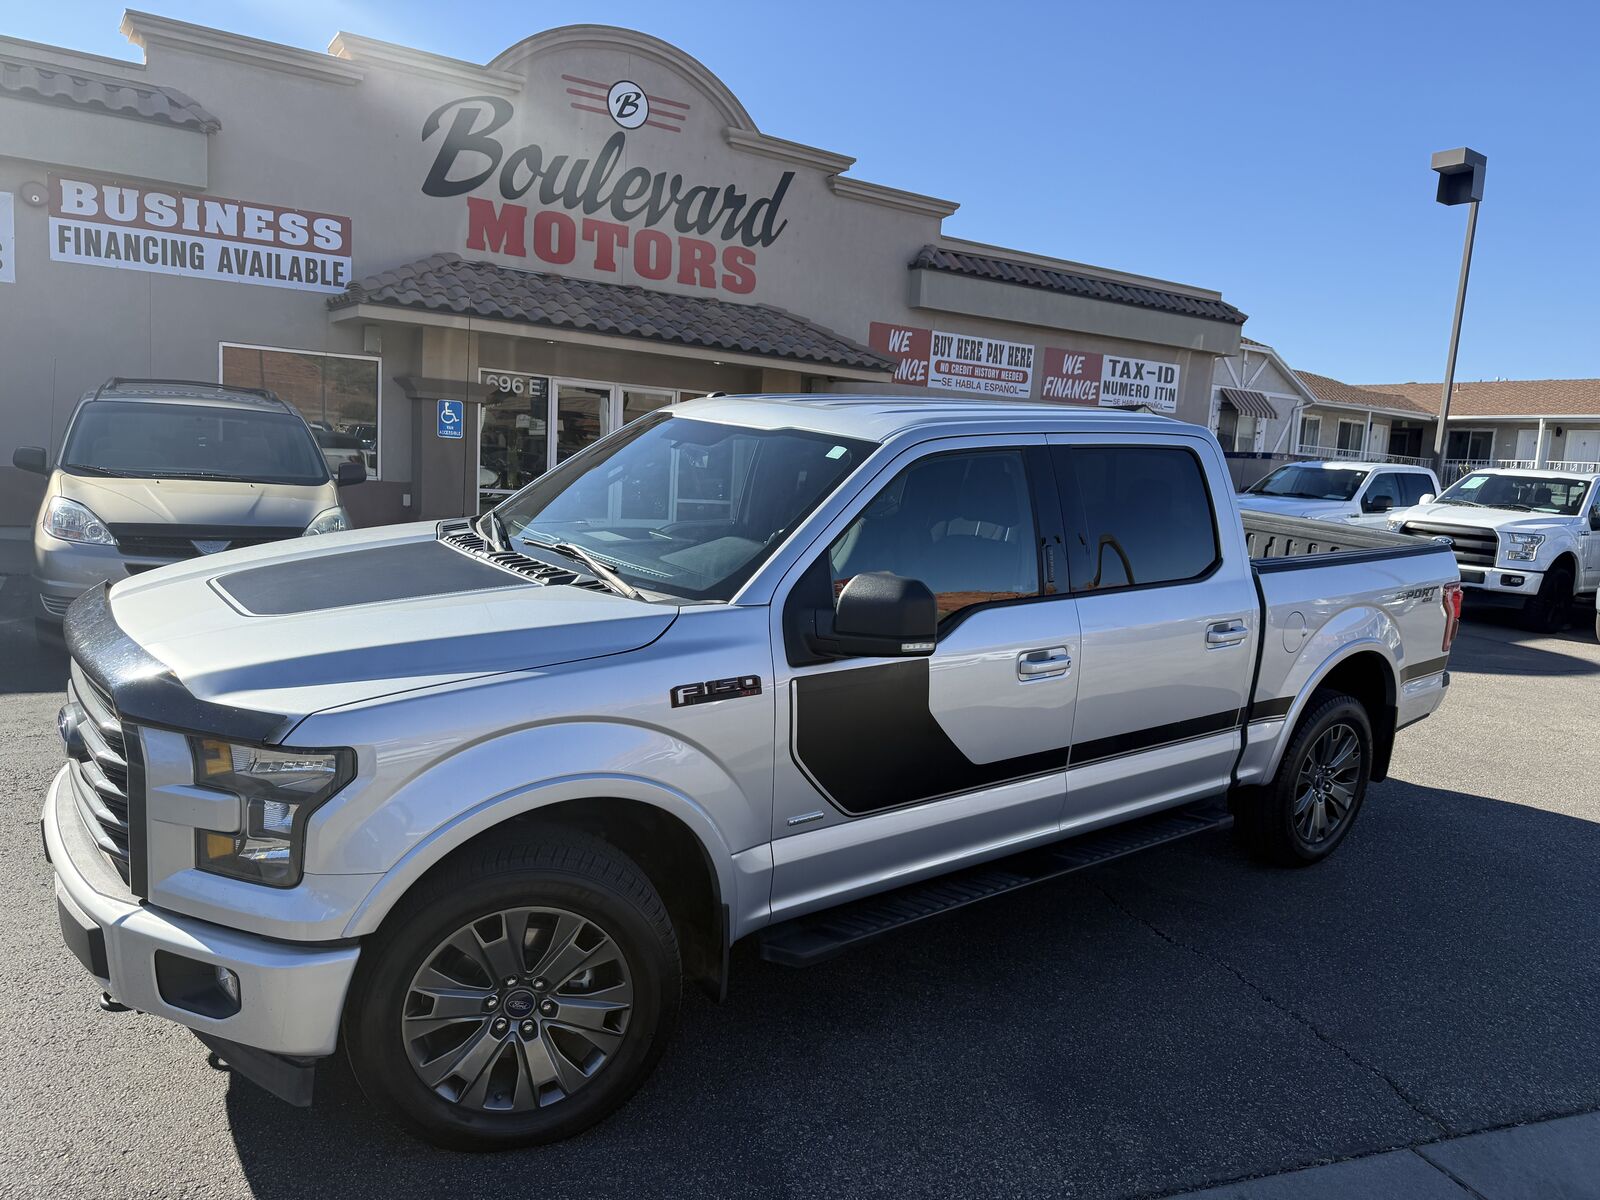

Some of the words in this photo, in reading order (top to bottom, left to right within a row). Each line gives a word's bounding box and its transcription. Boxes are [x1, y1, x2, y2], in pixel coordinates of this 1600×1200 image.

[615, 91, 641, 118] B
[421, 95, 796, 248] Boulevard
[60, 178, 343, 250] BUSINESS
[58, 224, 204, 270] FINANCING
[217, 246, 345, 287] AVAILABLE
[466, 196, 757, 294] MOTORS
[888, 328, 913, 353] WE
[932, 334, 953, 358] BUY
[956, 338, 983, 362] HERE
[986, 342, 1005, 365] PAY
[1007, 345, 1033, 369] HERE
[895, 358, 928, 381] NCE
[939, 362, 949, 373] NO
[950, 364, 973, 376] CREDIT
[974, 368, 1000, 379] HISTORY
[1000, 371, 1024, 382] NEEDED
[1062, 353, 1086, 375] WE
[1109, 359, 1175, 384] TAX-ID
[941, 377, 952, 387] SE
[955, 379, 981, 390] HABLA
[984, 382, 1019, 394] ESPAÑOL
[1043, 376, 1100, 400] FINANCE
[1102, 380, 1150, 399] NUMERO
[1154, 386, 1176, 402] ITIN
